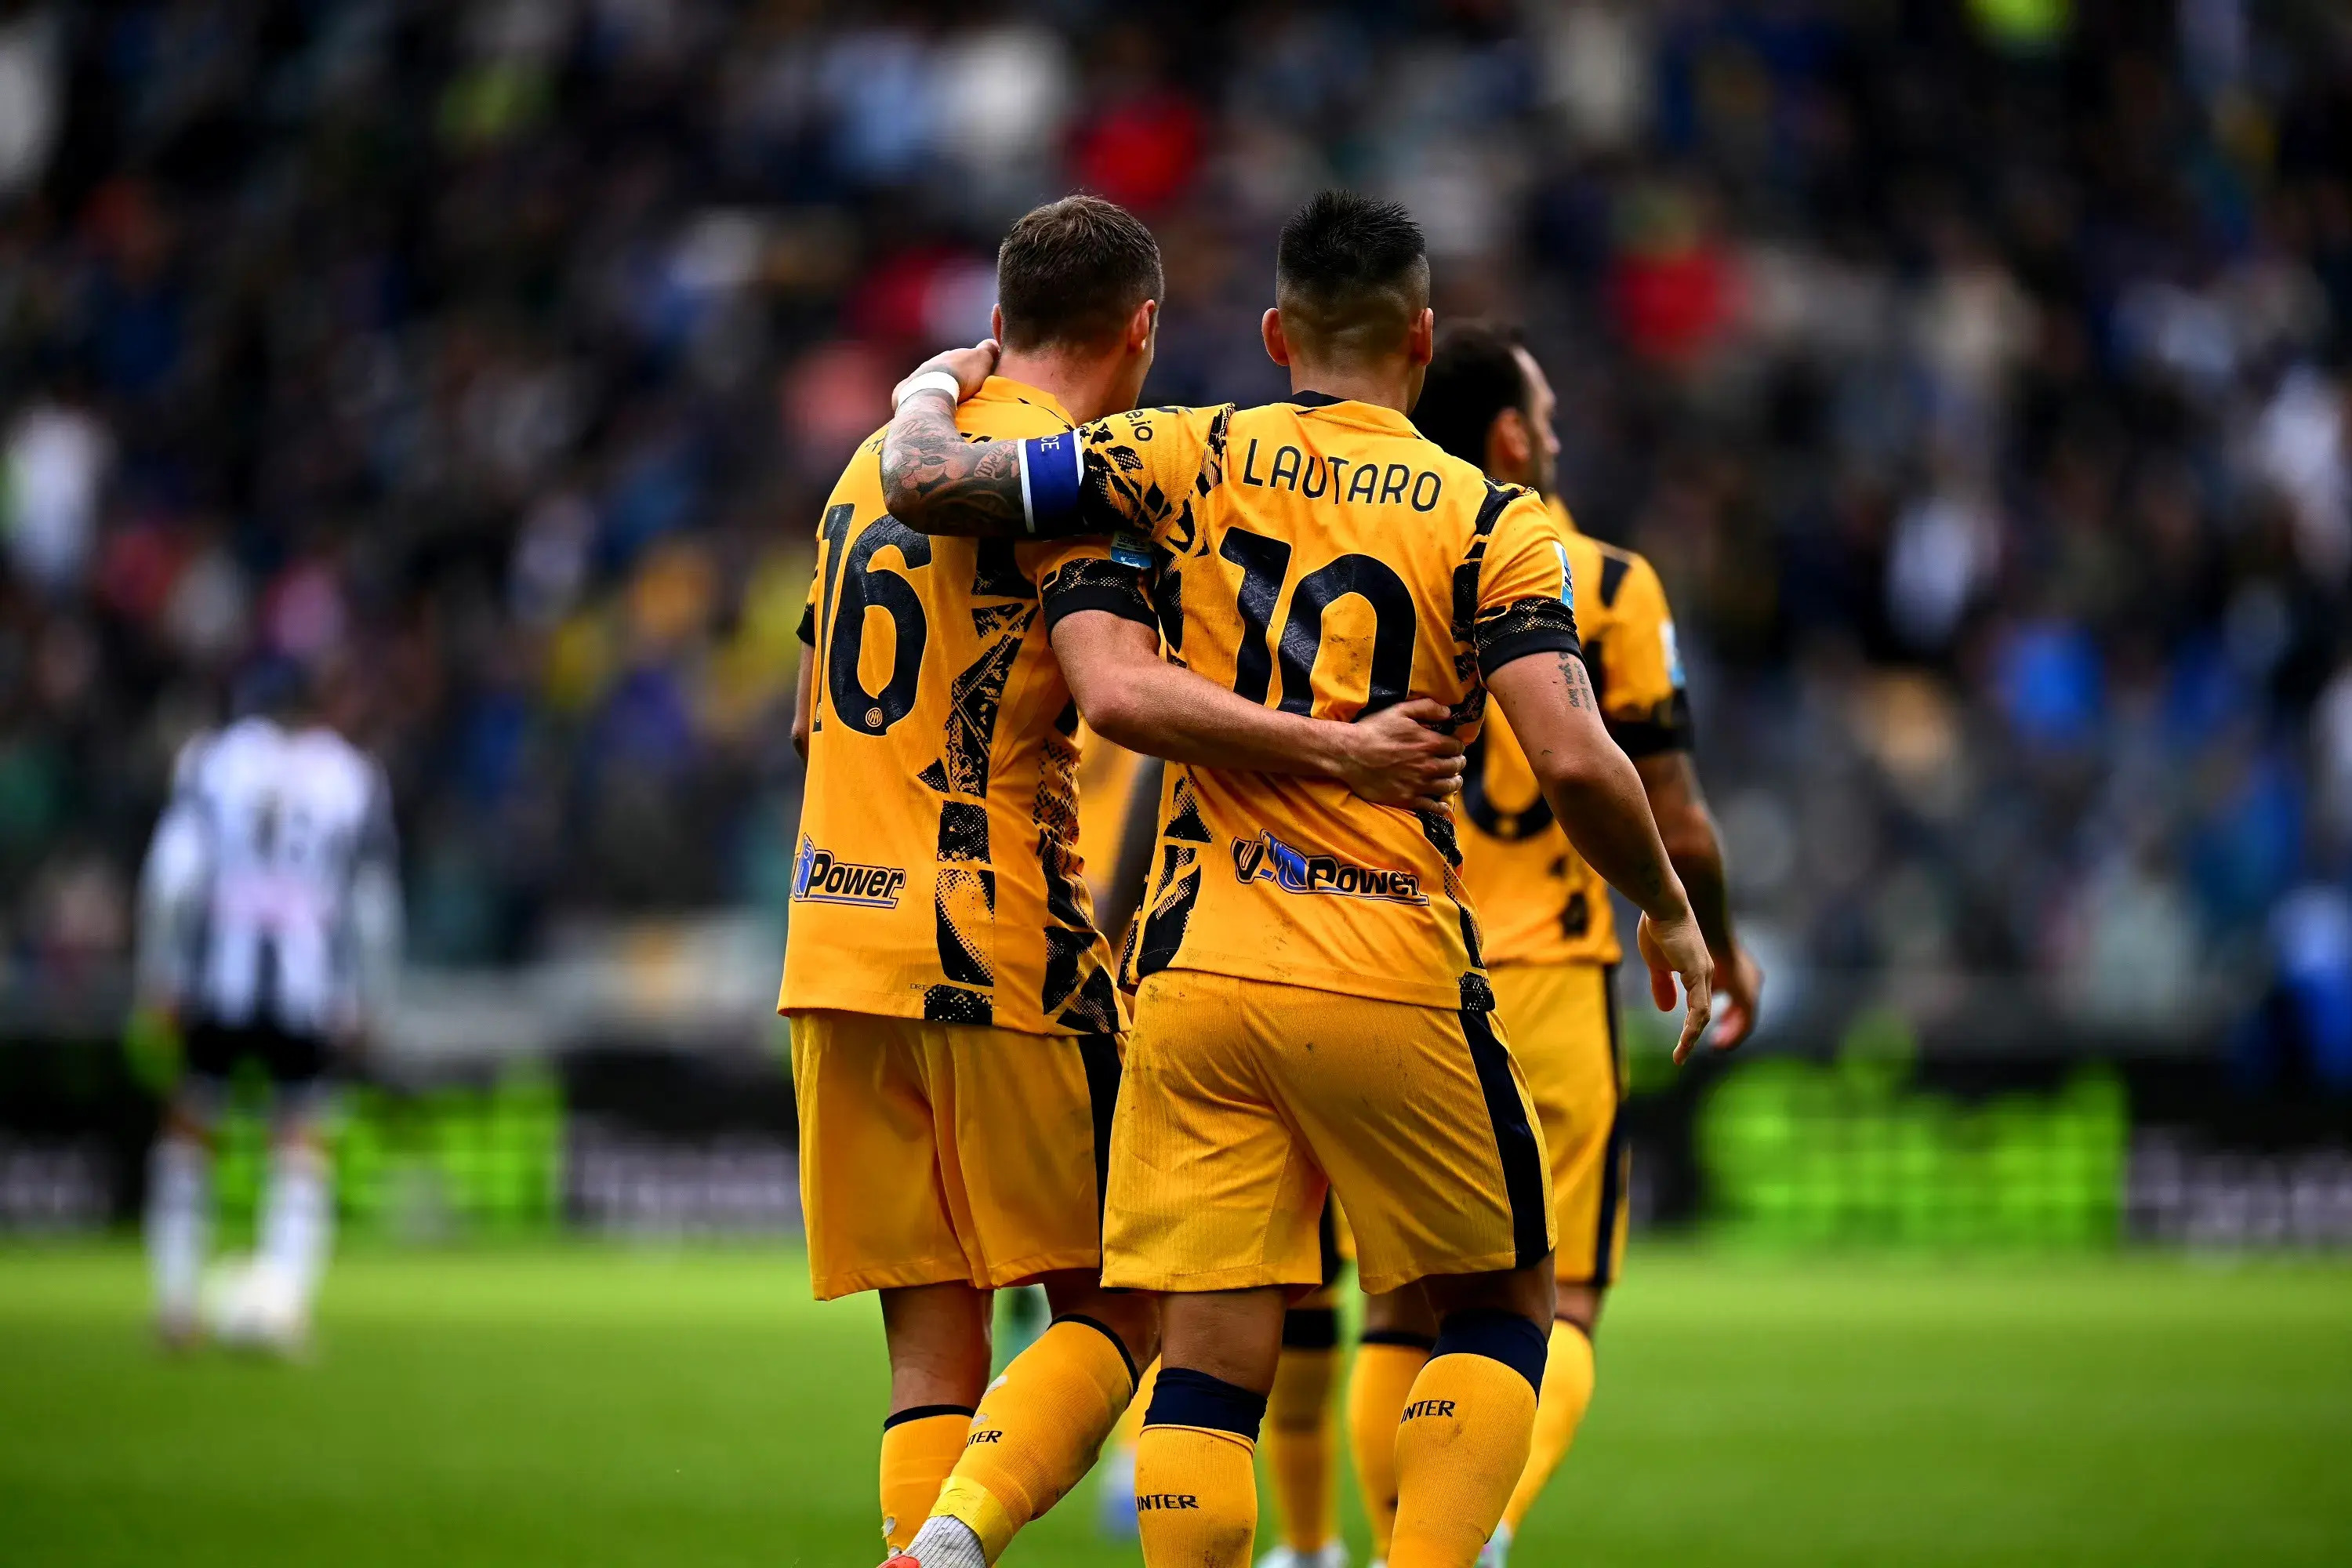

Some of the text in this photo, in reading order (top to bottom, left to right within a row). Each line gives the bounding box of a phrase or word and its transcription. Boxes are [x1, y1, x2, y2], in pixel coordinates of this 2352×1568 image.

[1125, 411, 1153, 441] e.io
[1243, 438, 1442, 513] LAUTARO
[811, 503, 932, 736] 16
[1219, 527, 1417, 723] 10
[795, 852, 904, 898] Power
[1401, 1399, 1456, 1424] INTER
[1137, 1494, 1200, 1512] INTER
